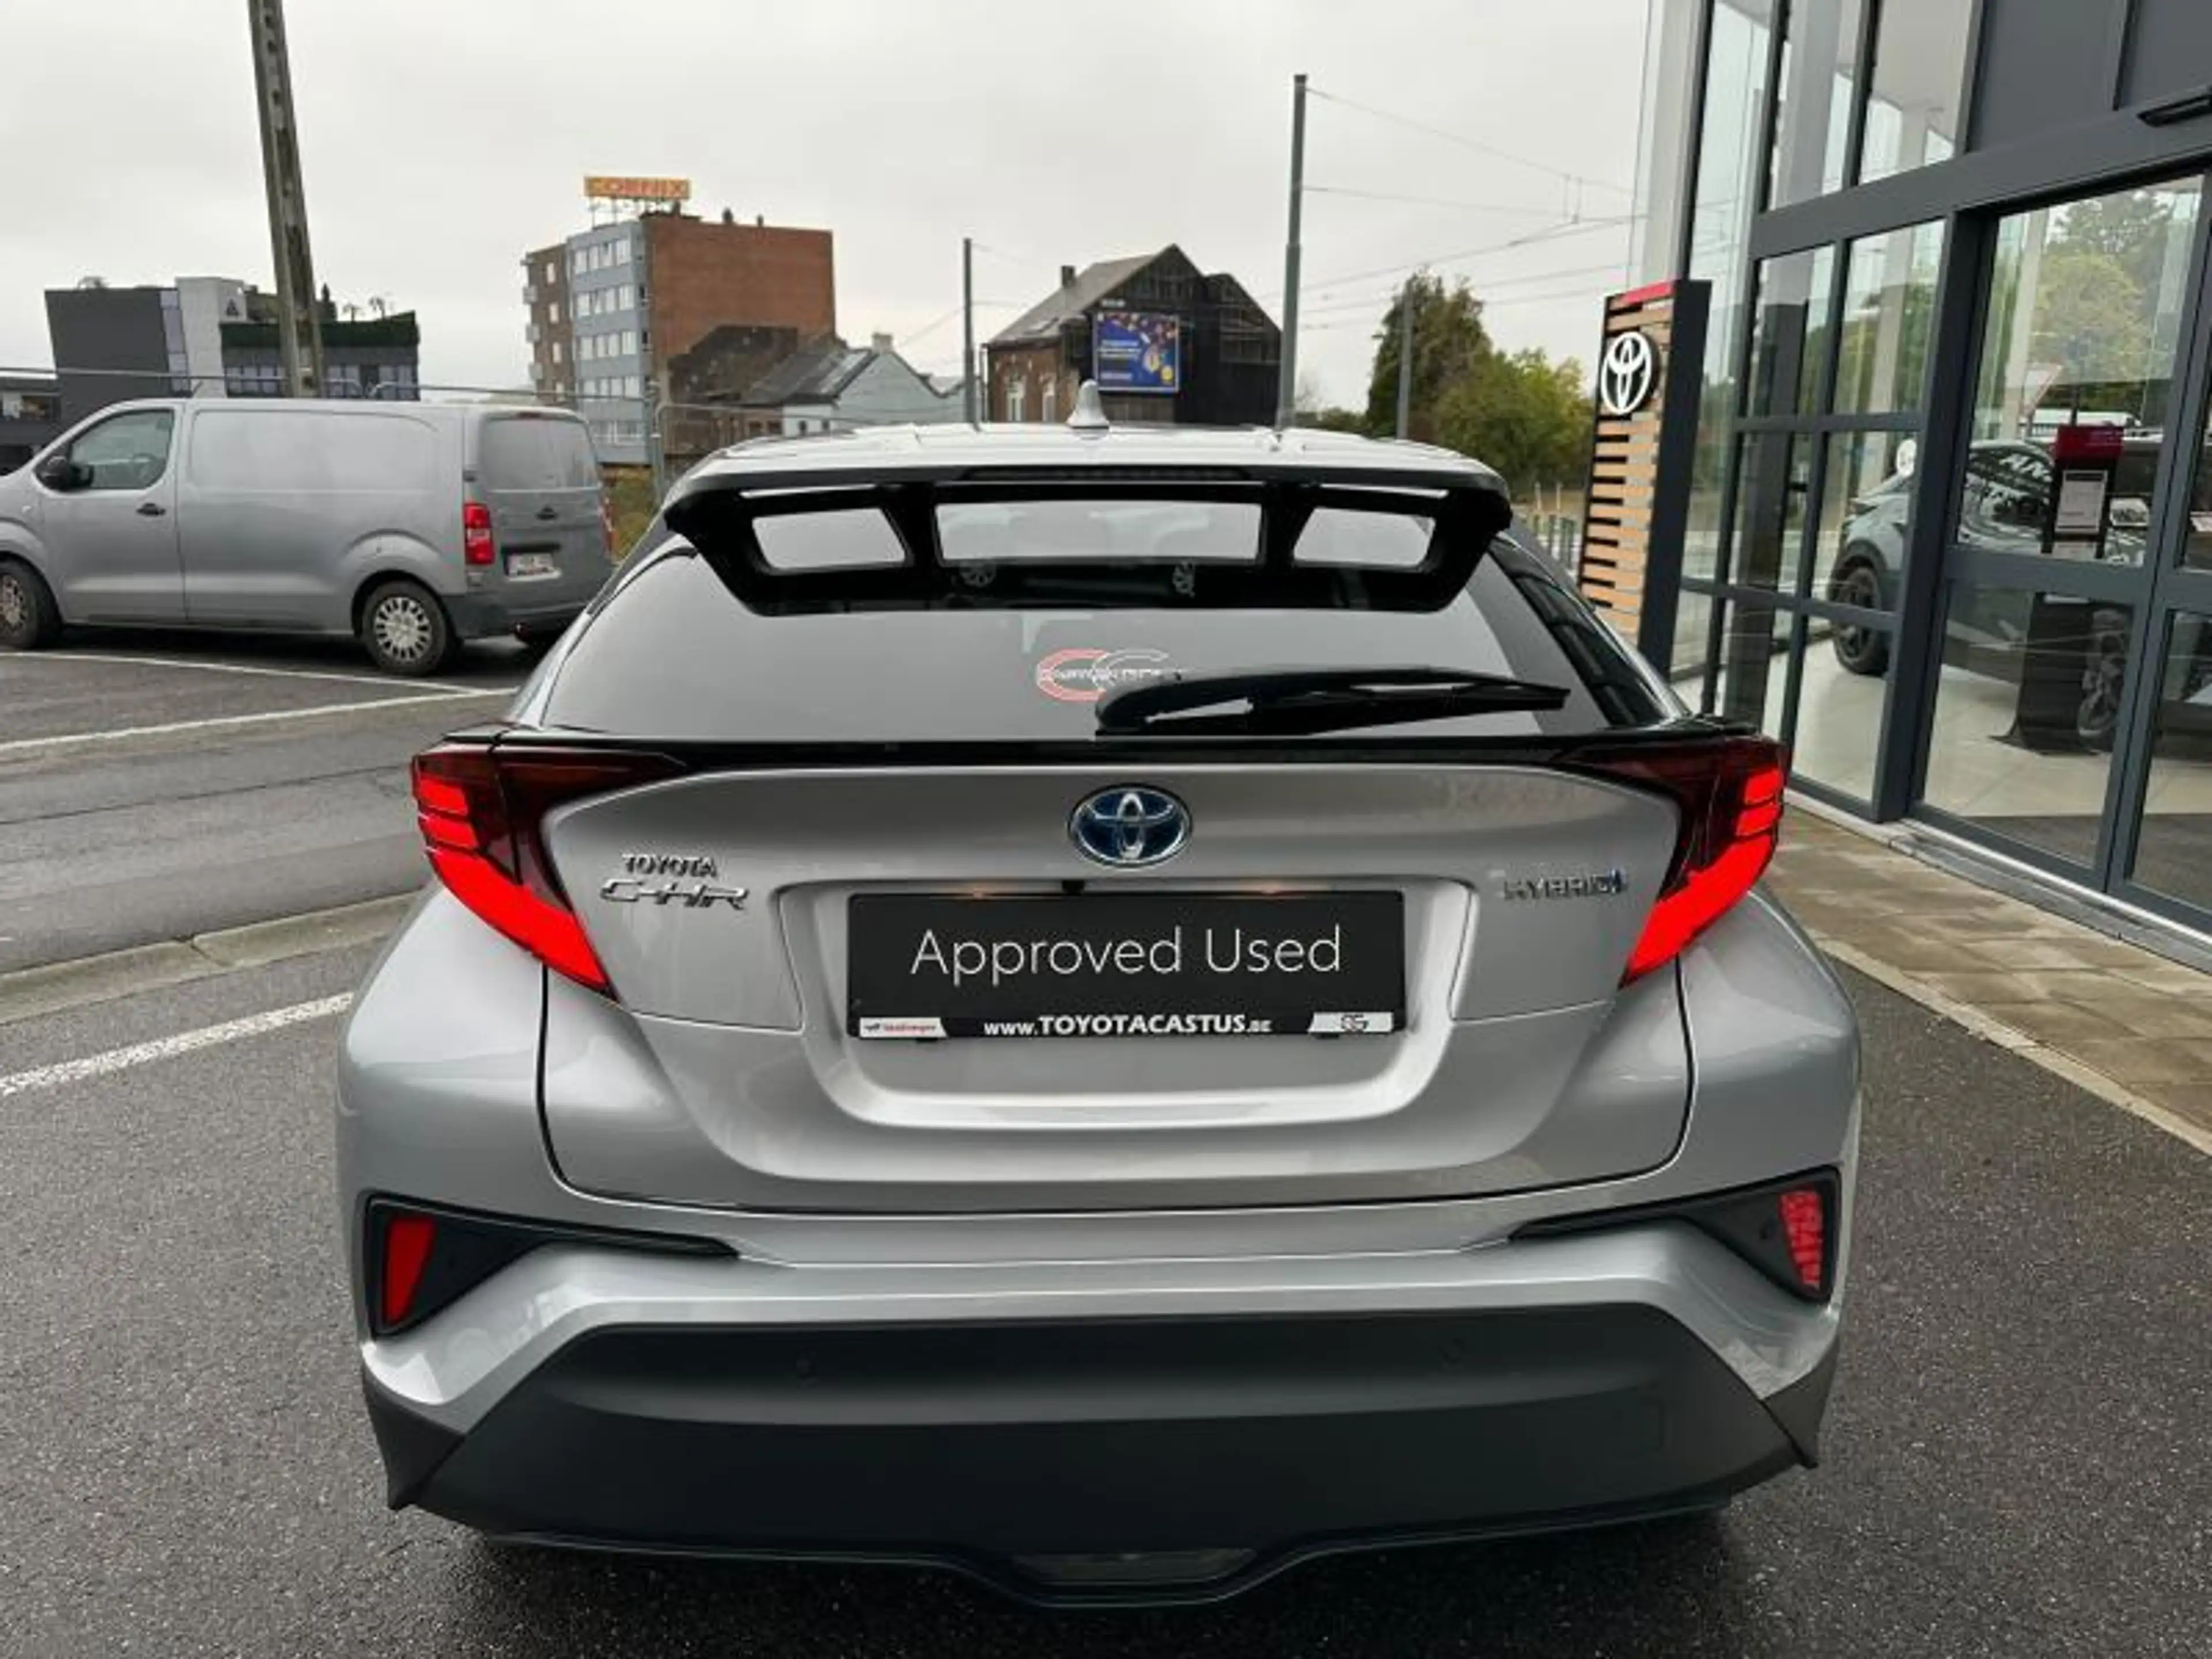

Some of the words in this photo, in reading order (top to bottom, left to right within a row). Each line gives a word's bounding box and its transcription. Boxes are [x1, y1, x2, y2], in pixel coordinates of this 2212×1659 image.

[621, 854, 717, 877] TOYOTA
[601, 878, 749, 910] C-HR
[1503, 872, 1621, 900] HYBRID
[910, 925, 1181, 986] Approved
[1206, 923, 1340, 972] Used
